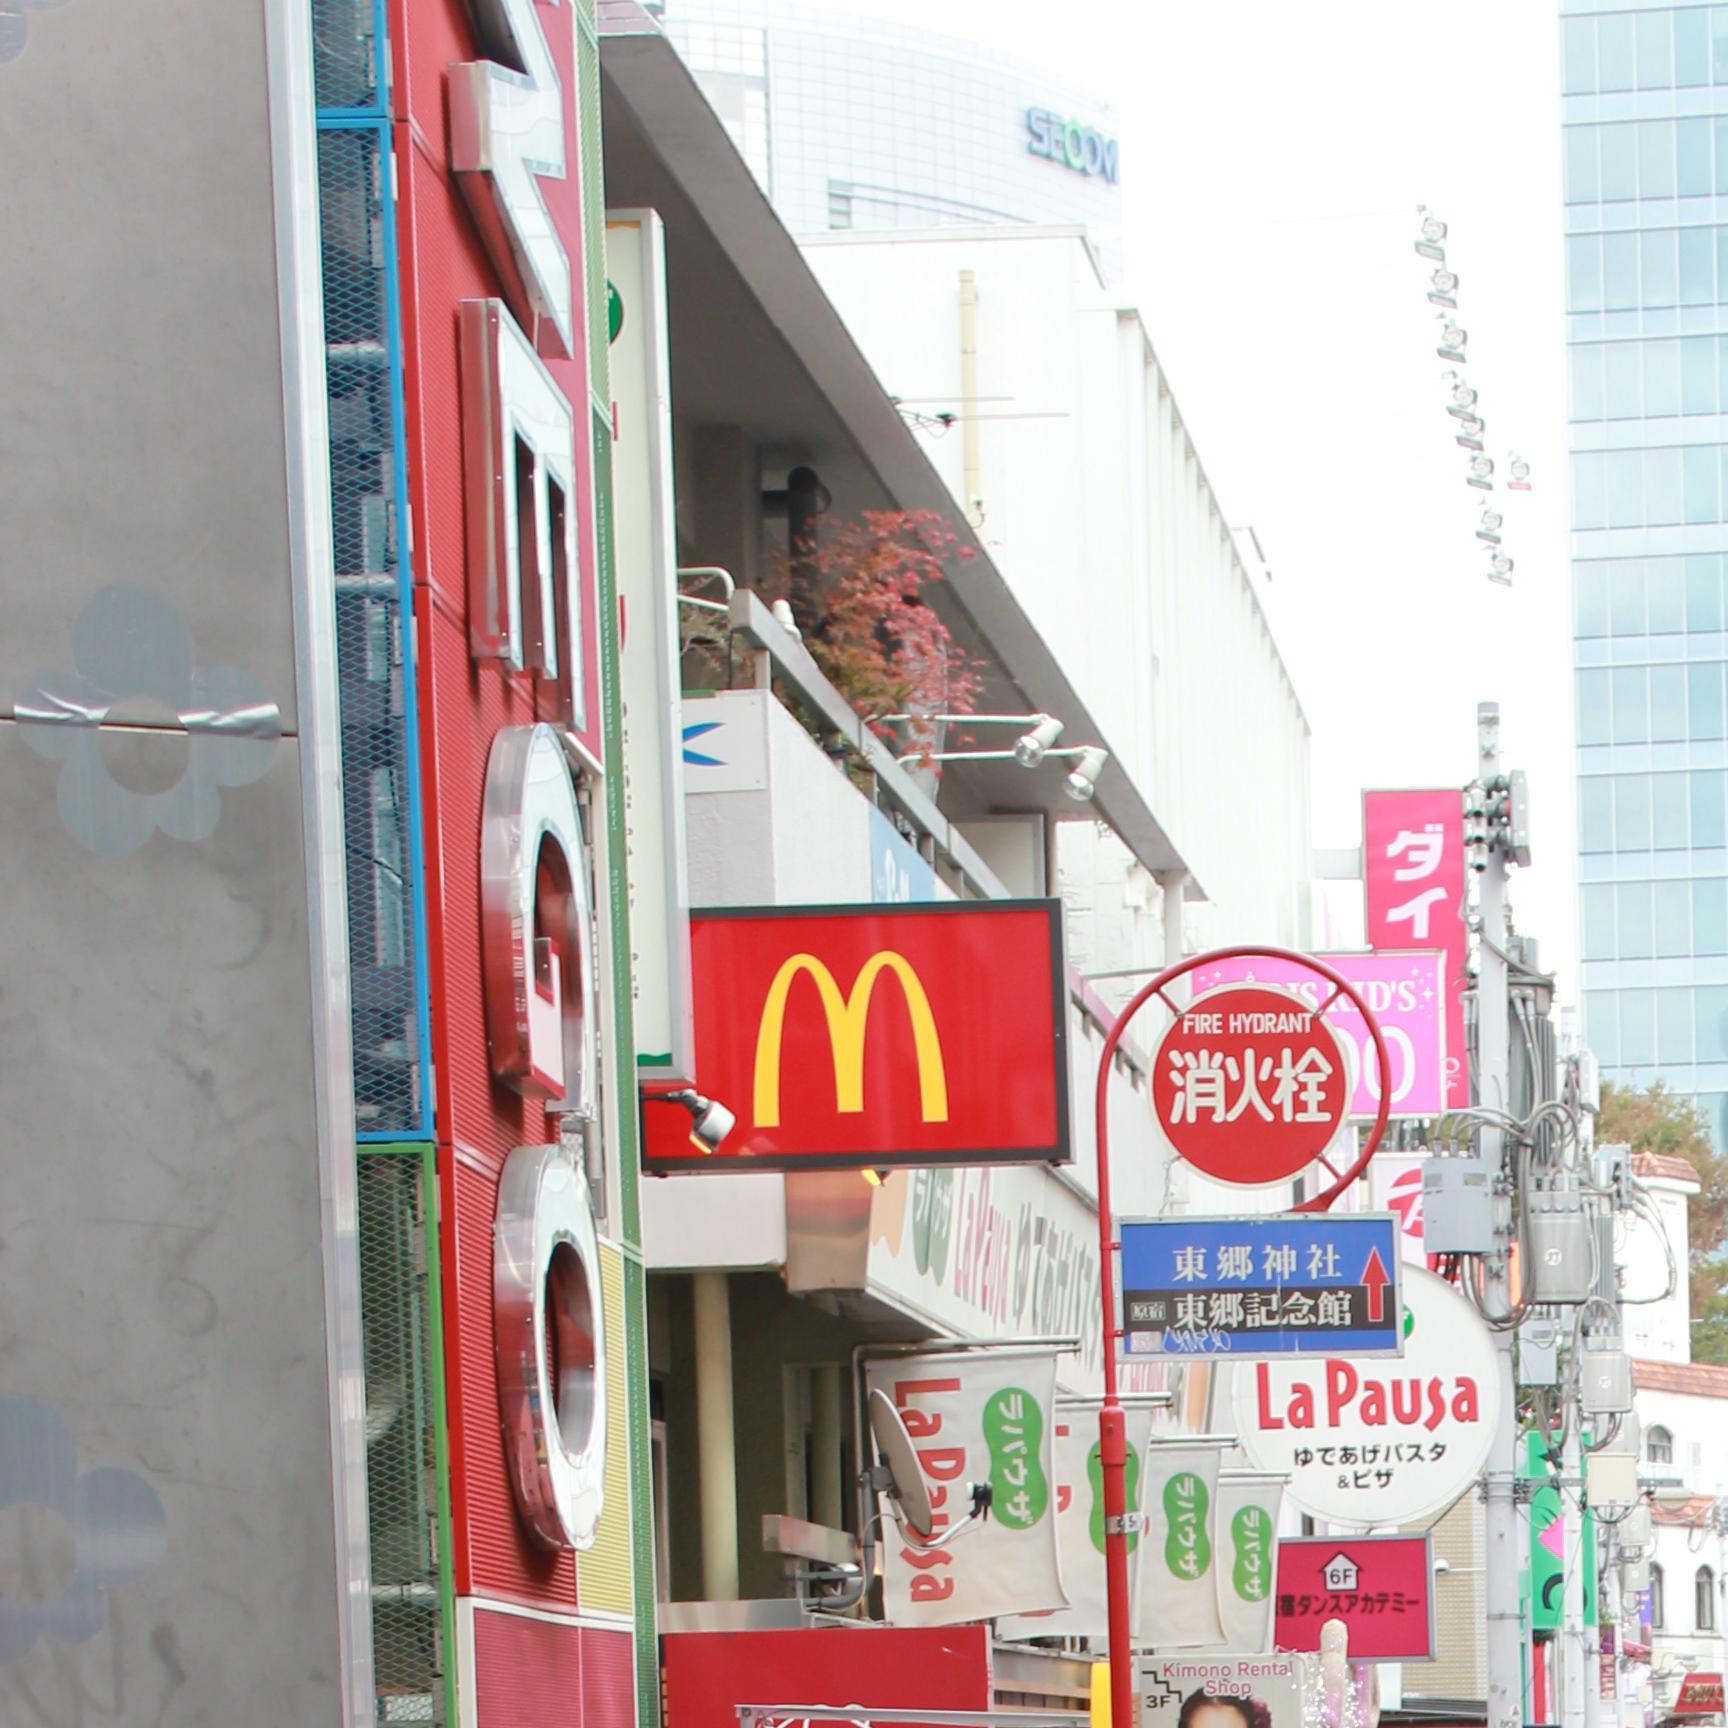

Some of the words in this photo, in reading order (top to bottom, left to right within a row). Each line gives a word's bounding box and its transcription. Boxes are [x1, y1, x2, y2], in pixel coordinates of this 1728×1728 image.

[1182, 1013, 1223, 1035] FIRE
[1229, 1012, 1315, 1034] HYDRANT
[1167, 1046, 1333, 1125] 消火栓
[1172, 1245, 1342, 1282] 東郷神社
[1133, 1303, 1164, 1320] 原宿
[1173, 1291, 1353, 1329] 東郷記念館
[998, 1392, 1034, 1526] ラパウザ
[1293, 1440, 1448, 1468] ゆであげパスタ
[1174, 1475, 1200, 1580] ラパウザ
[1329, 1567, 1353, 1587] 6F
[1162, 1662, 1232, 1679] Kimono
[1237, 1659, 1294, 1677] Rental
[1145, 1695, 1170, 1709] 3F
[1205, 1680, 1252, 1699] Shop
